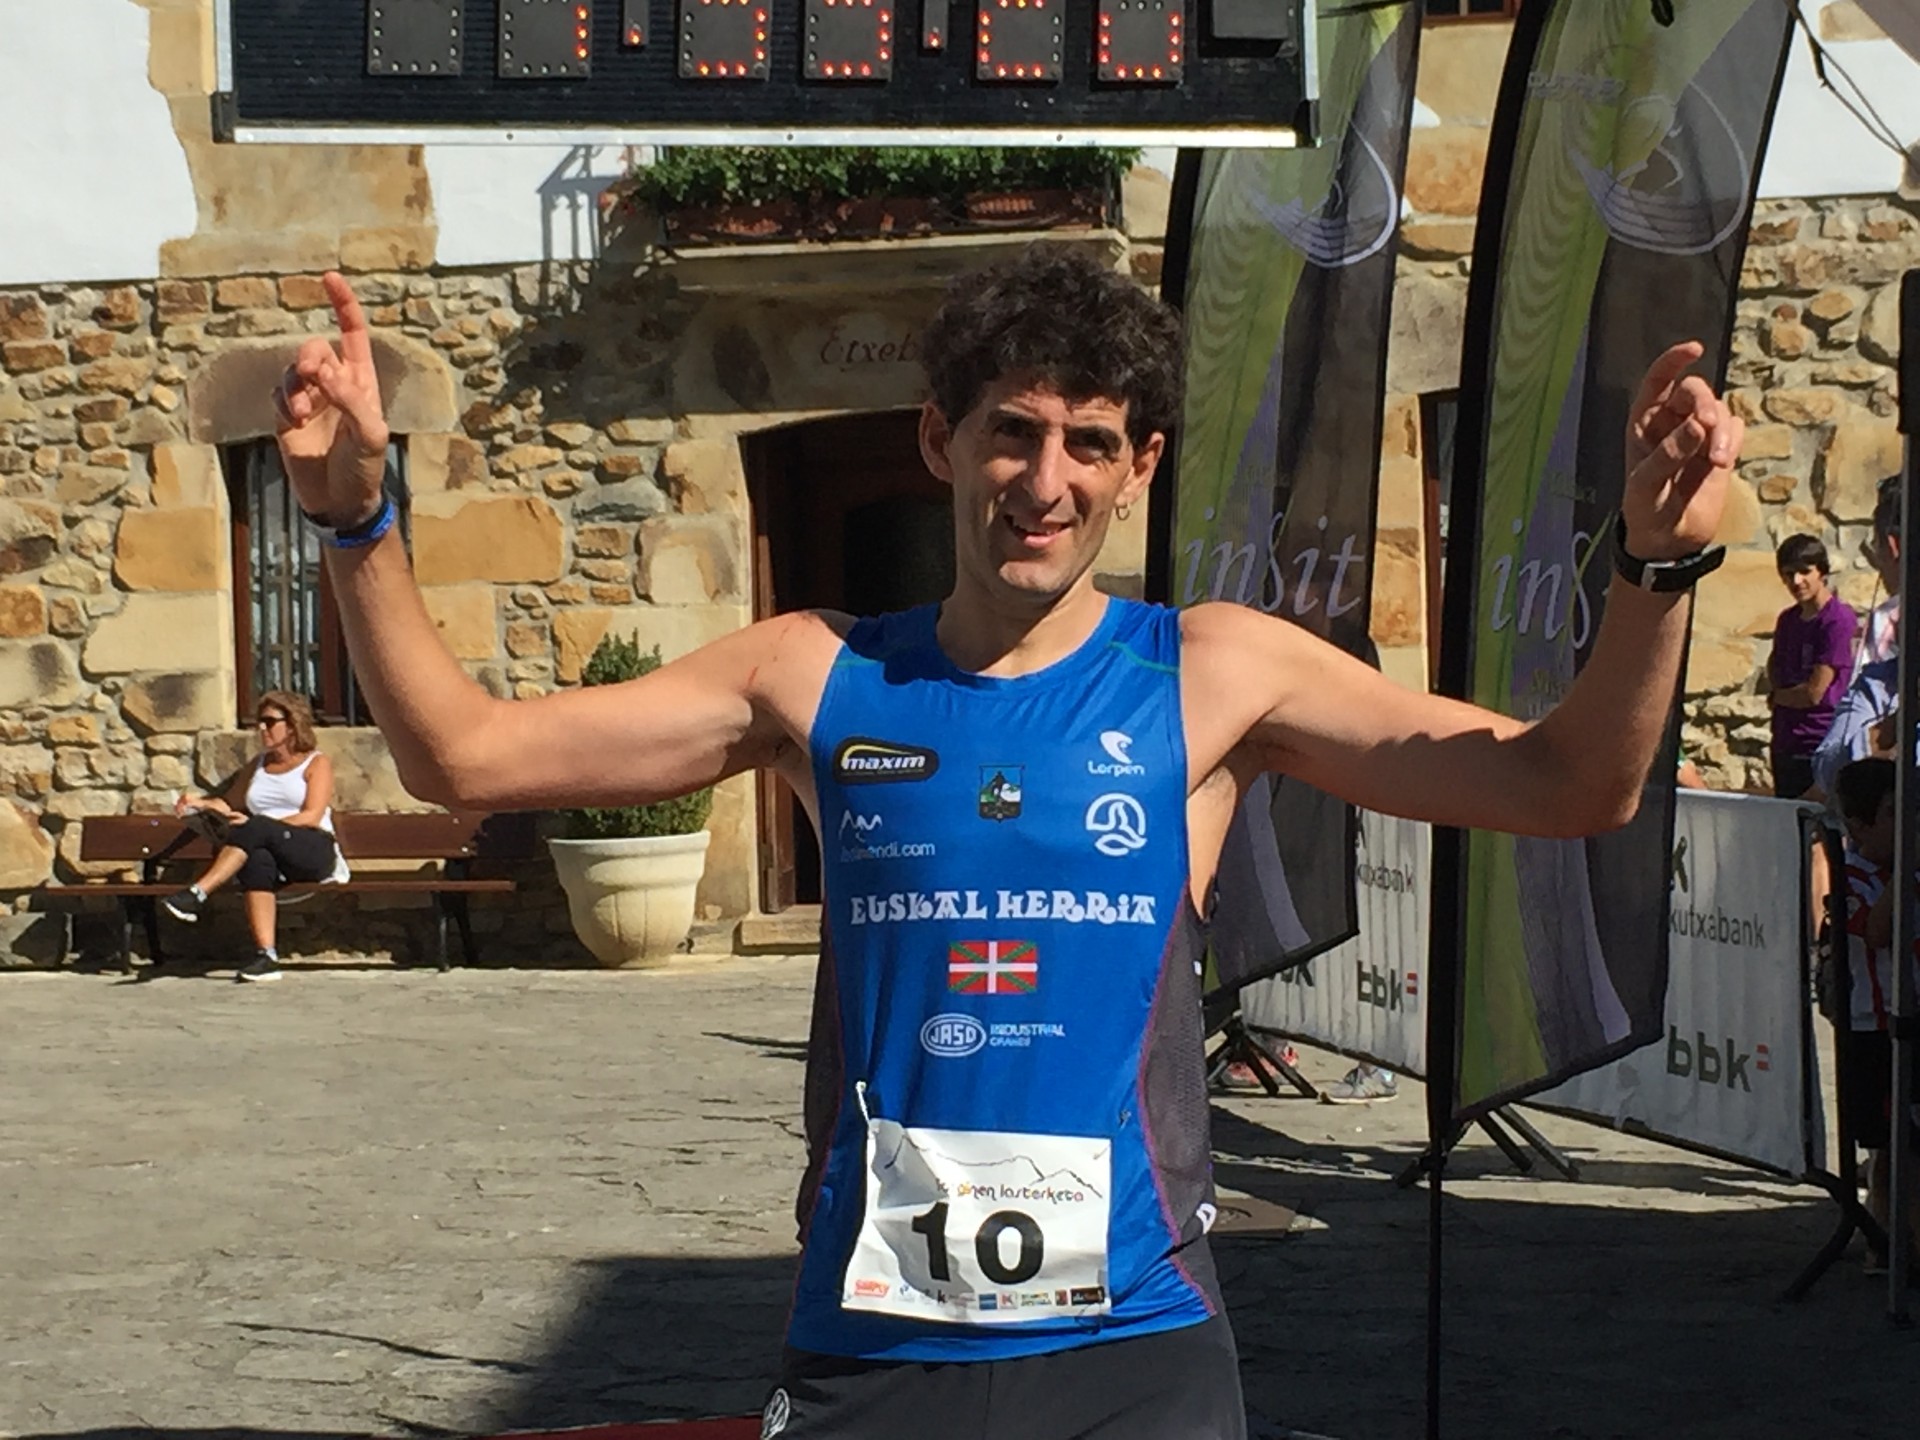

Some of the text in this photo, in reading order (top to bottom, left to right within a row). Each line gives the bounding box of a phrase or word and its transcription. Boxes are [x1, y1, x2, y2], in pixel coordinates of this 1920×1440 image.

[1184, 508, 1366, 618] insit
[841, 754, 926, 770] maxim
[1087, 760, 1145, 777] Lorpen
[851, 891, 988, 925] EUSKAL
[1669, 904, 1766, 948] kutxabank
[929, 1023, 978, 1047] JASO
[912, 1201, 1044, 1285] 10
